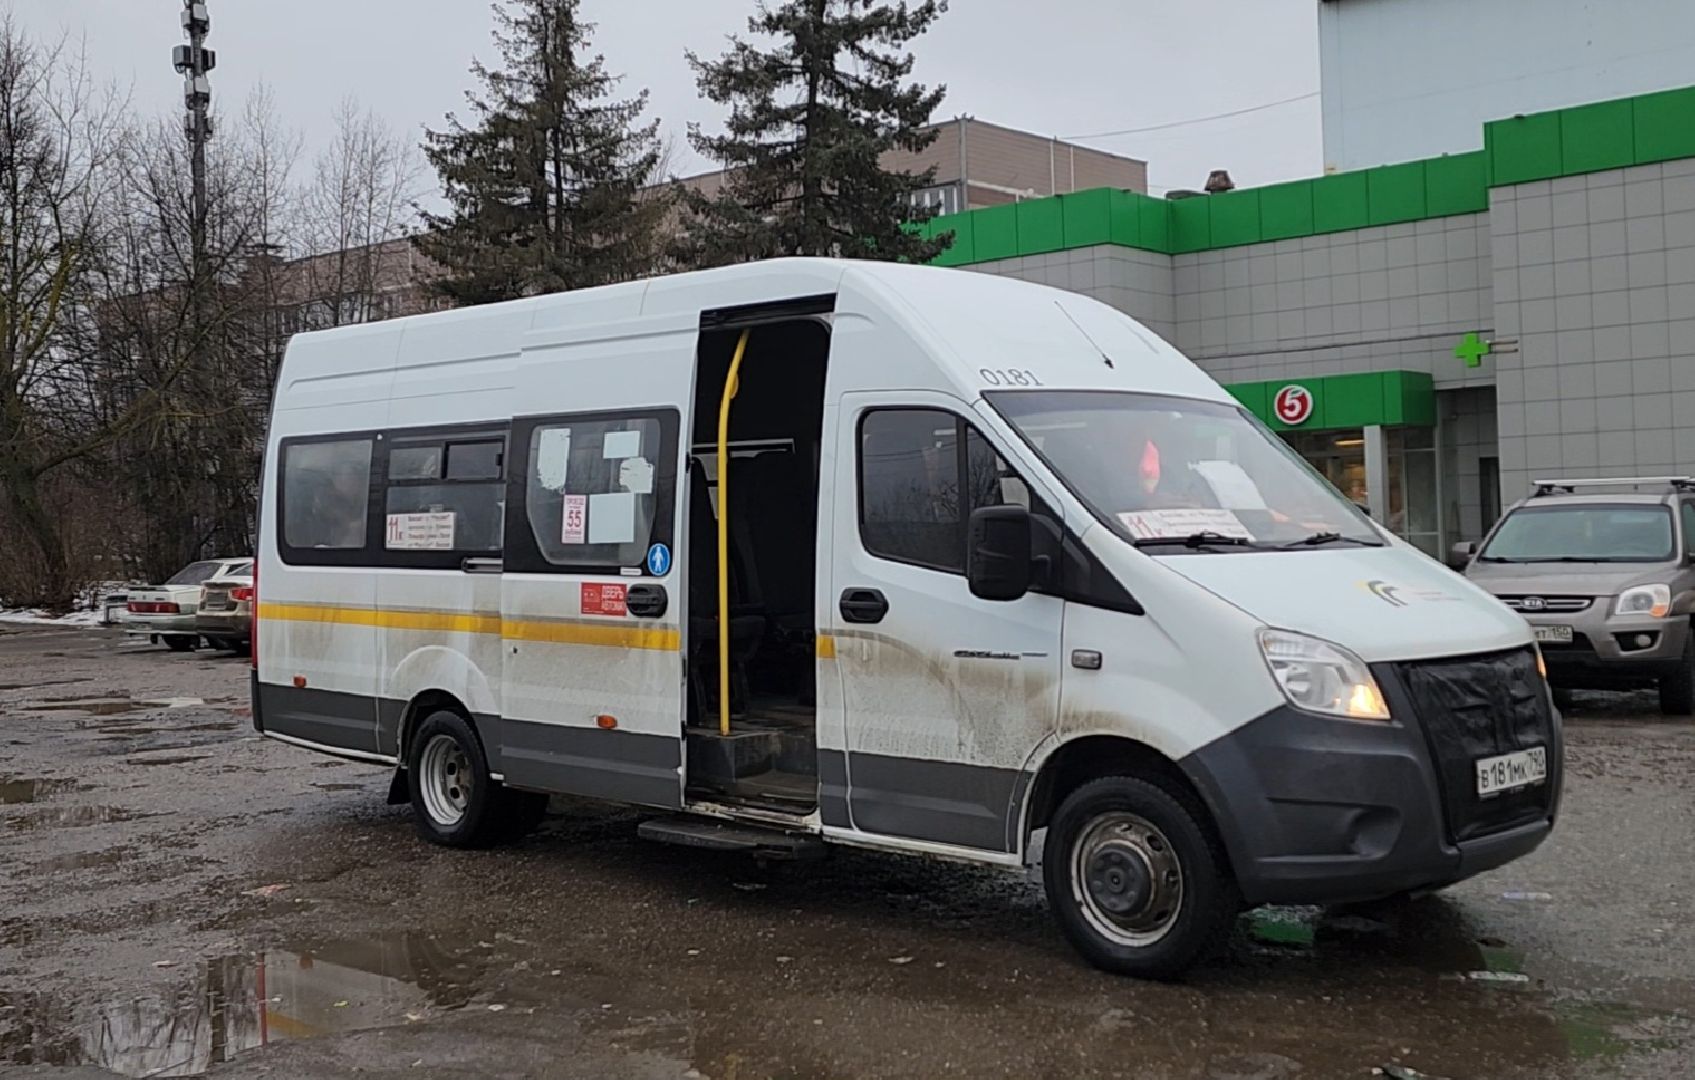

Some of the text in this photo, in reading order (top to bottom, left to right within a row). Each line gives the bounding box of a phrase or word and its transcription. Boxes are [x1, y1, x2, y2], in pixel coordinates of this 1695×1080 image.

[979, 368, 1044, 386] 0181
[1284, 387, 1304, 418] 5
[566, 509, 582, 528] 55
